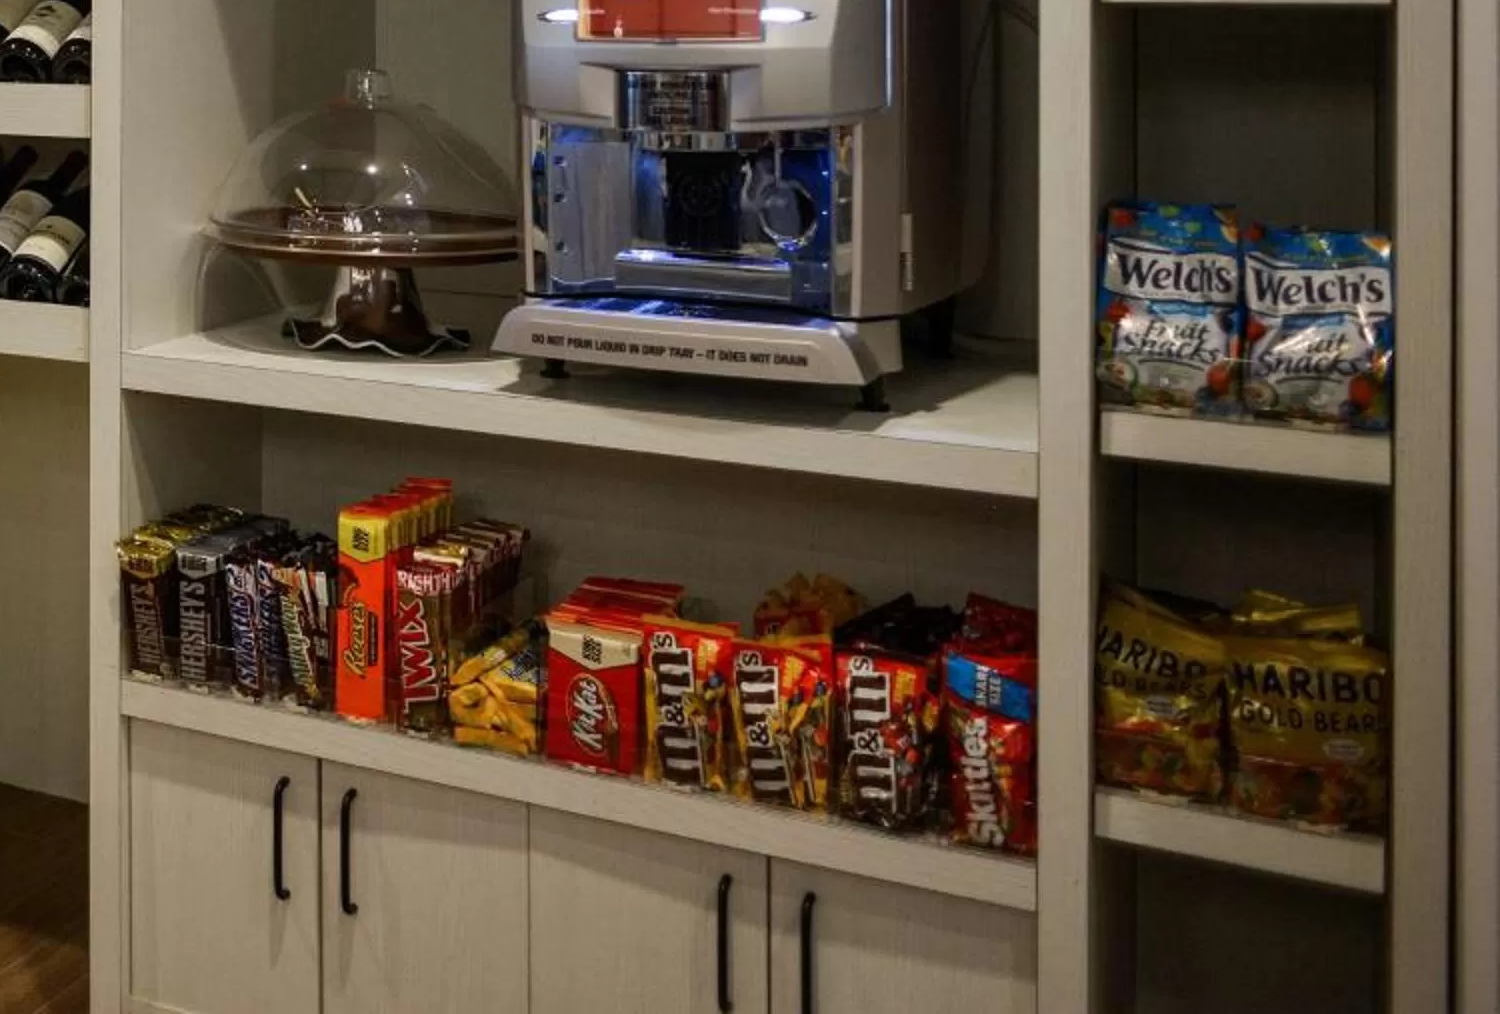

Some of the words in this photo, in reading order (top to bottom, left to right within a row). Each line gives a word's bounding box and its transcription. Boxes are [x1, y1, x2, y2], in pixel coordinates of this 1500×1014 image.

[1117, 252, 1233, 295] Welch's
[1251, 265, 1385, 306] Welch's
[531, 332, 545, 345] DO
[547, 334, 565, 347] NOT
[567, 336, 593, 349] POUR
[595, 339, 627, 353] LIQUID
[629, 343, 639, 355] IN
[642, 344, 666, 356] DRIP
[669, 346, 694, 359] TRAY
[705, 349, 716, 361] IT
[718, 349, 747, 363] DOES
[750, 352, 772, 364] NOT
[773, 353, 809, 367] DRAIN
[179, 580, 208, 681] HERSHEY'S
[342, 599, 368, 679] Reese's
[397, 597, 440, 714] TWIX
[1231, 661, 1383, 704] HARIBO
[1239, 698, 1304, 731] GOLD
[1313, 710, 1382, 734] BEAR
[959, 716, 1006, 847] Skittles
